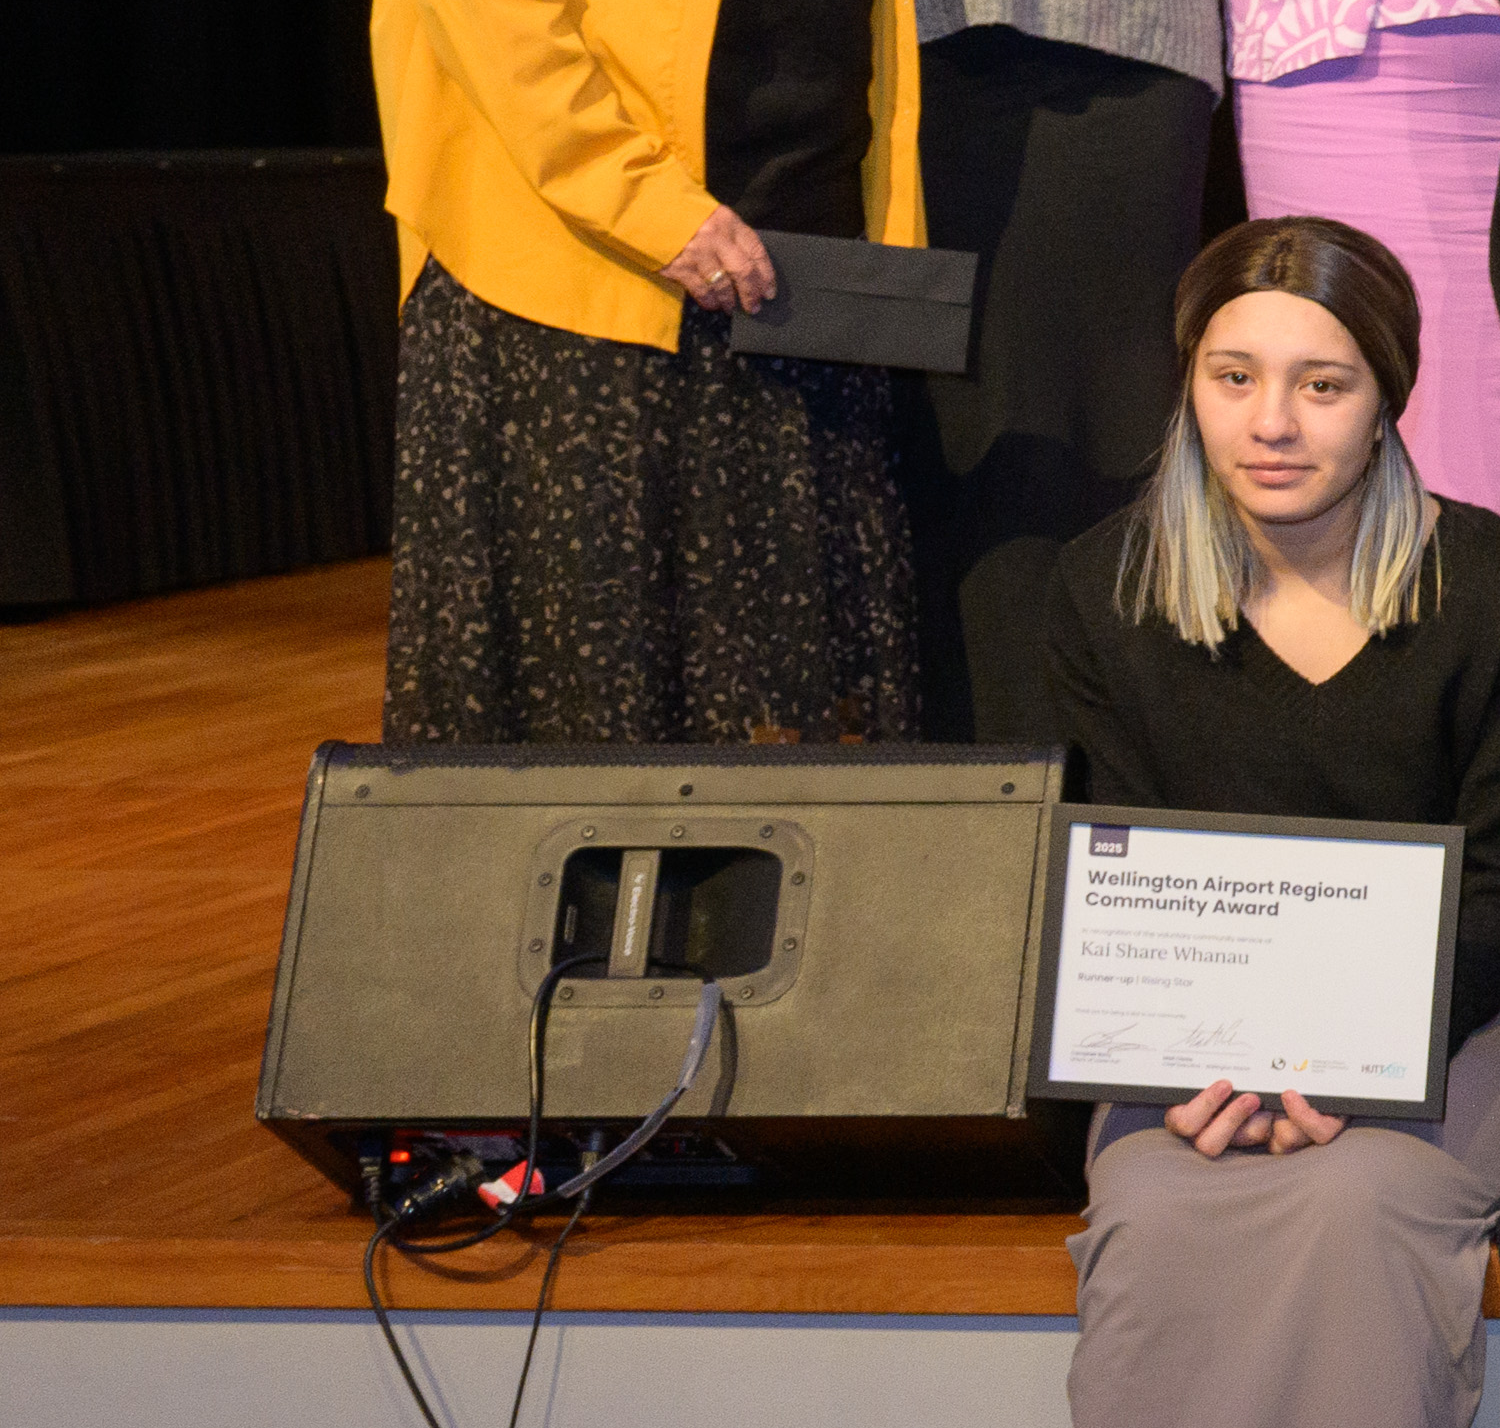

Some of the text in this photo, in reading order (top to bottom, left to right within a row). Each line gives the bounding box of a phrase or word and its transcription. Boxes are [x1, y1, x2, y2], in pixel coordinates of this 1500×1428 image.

[1095, 841, 1123, 854] 2025
[1088, 870, 1368, 902] Wellington Airport Regional
[1085, 891, 1280, 917] Community Award
[1081, 940, 1250, 965] Kai Share Whanau
[1078, 973, 1194, 988] Runner-up Rising Star
